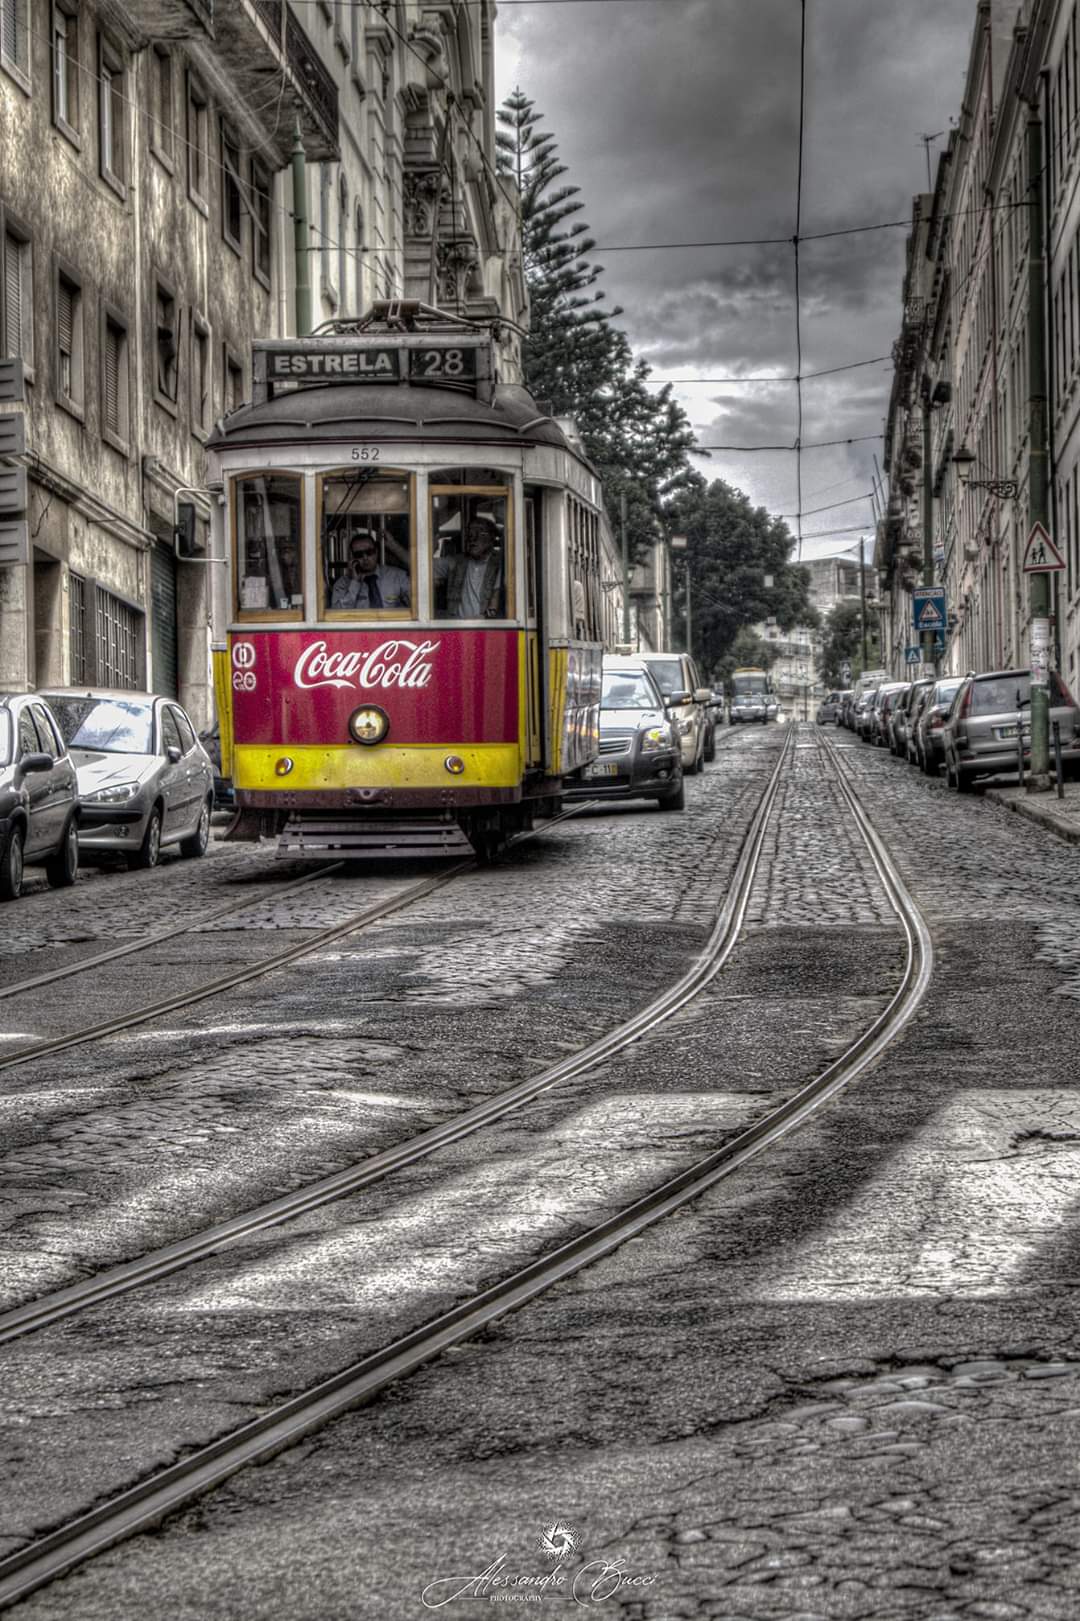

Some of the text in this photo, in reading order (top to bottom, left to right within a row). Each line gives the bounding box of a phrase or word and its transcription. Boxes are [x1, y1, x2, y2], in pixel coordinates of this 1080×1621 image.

[274, 353, 392, 373] ESTRELA
[424, 350, 464, 376] 28
[351, 447, 380, 461] 552
[294, 640, 441, 689] Coca-Cola
